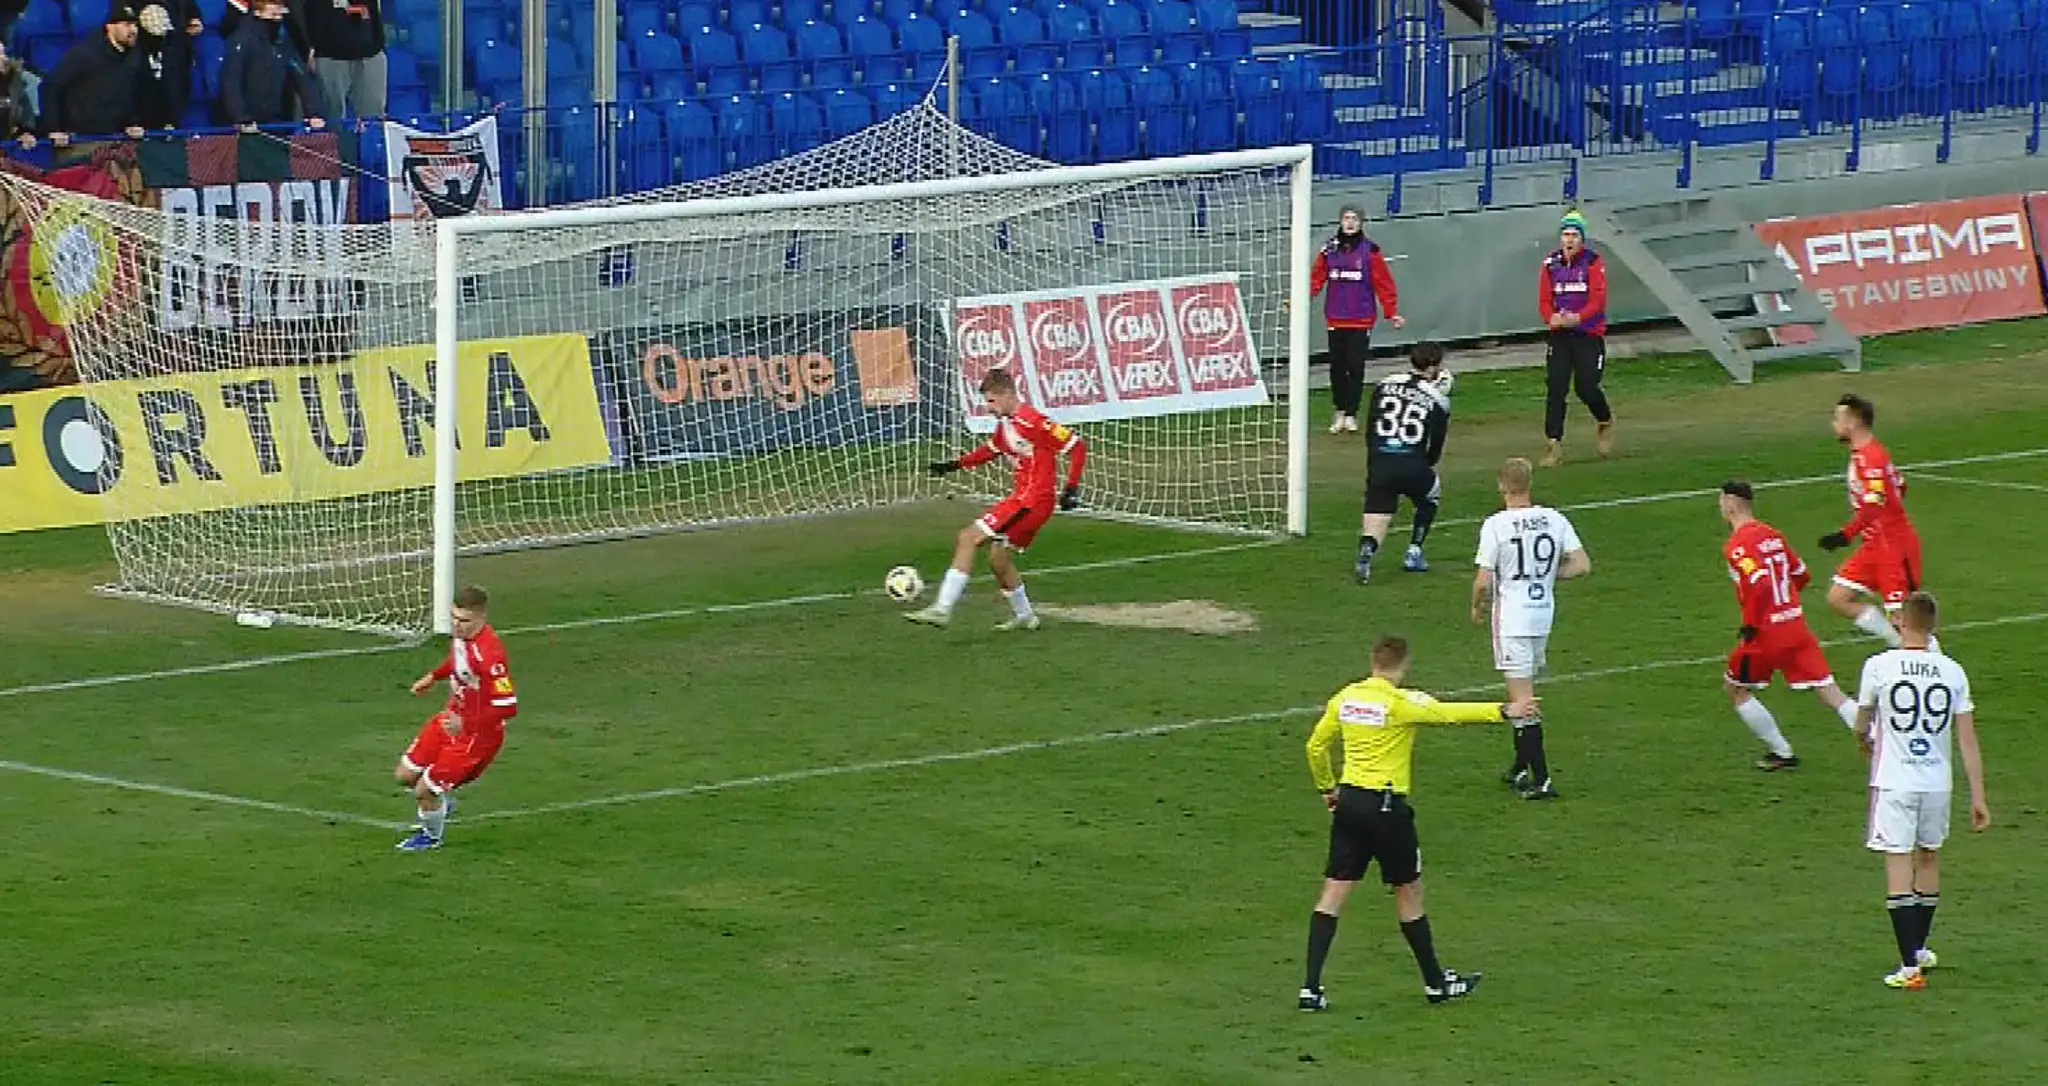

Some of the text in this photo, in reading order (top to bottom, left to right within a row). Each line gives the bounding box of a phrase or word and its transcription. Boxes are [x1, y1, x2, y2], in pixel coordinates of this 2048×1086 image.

[1817, 265, 2029, 311] STAVEBNINY
[1041, 321, 1083, 349] CBA
[1113, 314, 1158, 342] CBA
[1186, 307, 1229, 335] CBA
[965, 329, 1006, 356] CBA
[643, 343, 835, 411] Orange
[1510, 532, 1555, 580] 19
[1763, 551, 1791, 606] 17
[1900, 660, 1941, 678] LUKA
[1889, 680, 1952, 736] 99
